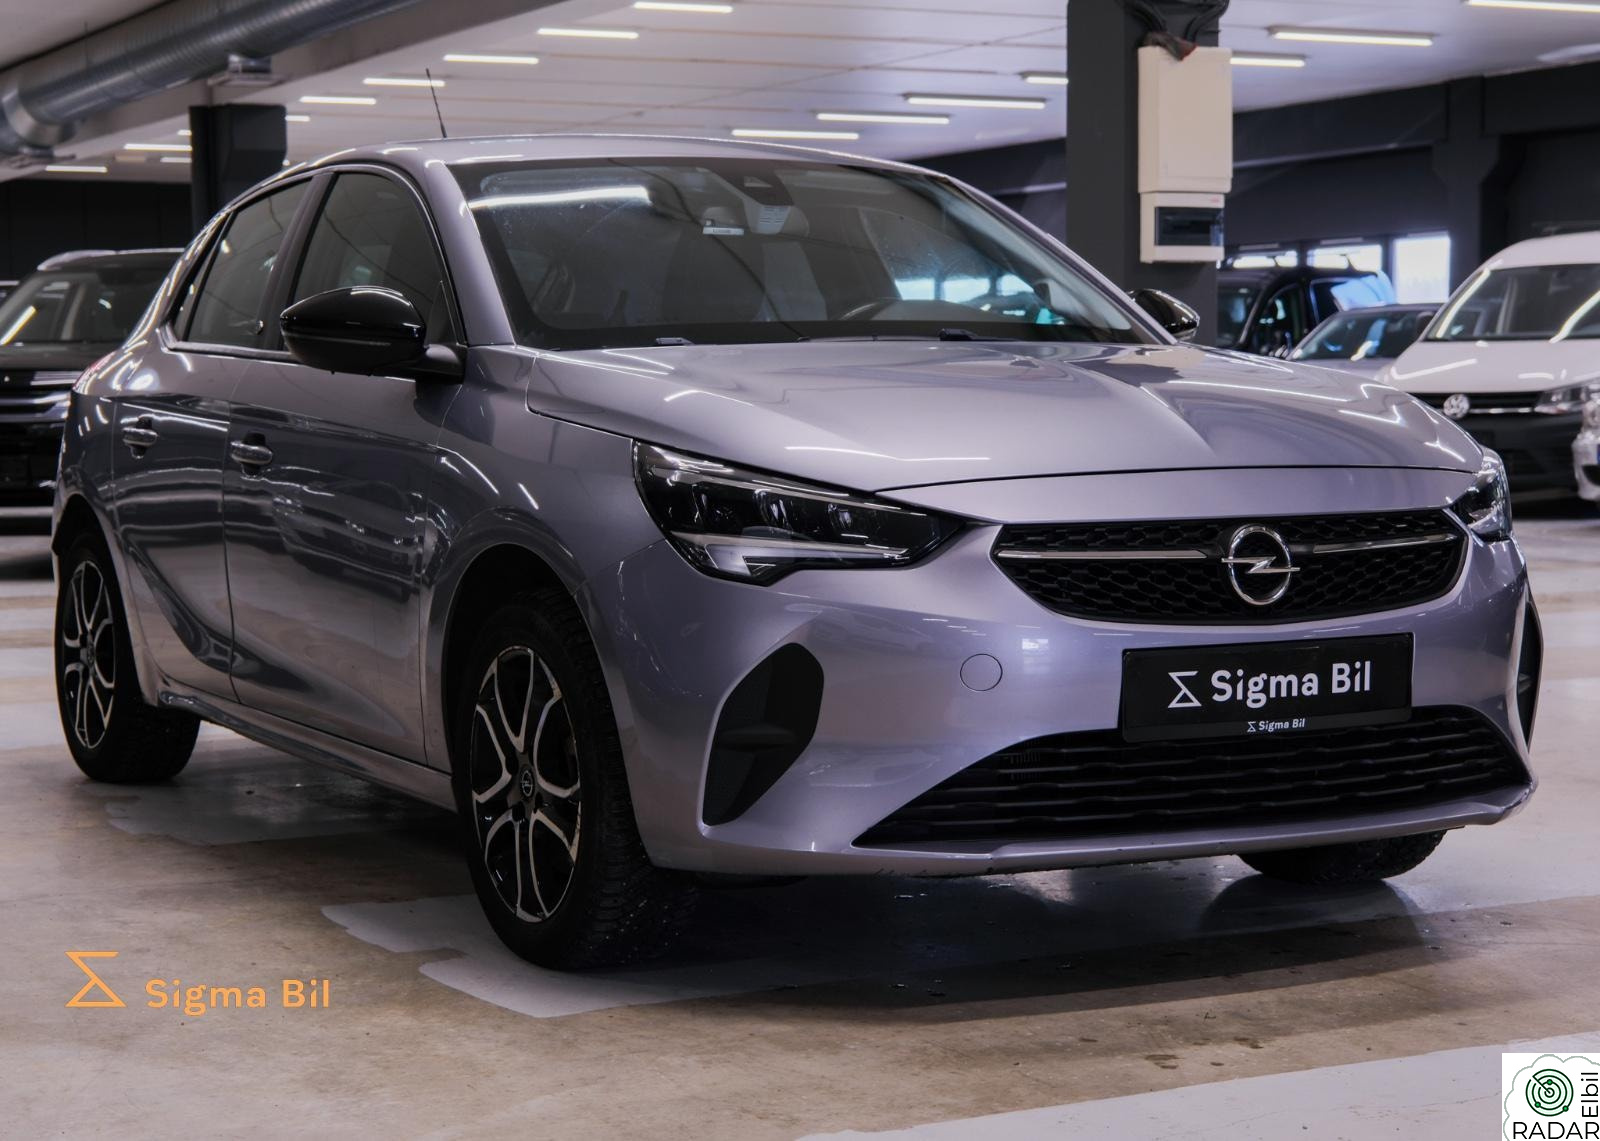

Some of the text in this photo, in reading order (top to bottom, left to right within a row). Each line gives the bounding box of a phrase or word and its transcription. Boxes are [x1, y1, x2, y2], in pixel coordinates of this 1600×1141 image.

[1211, 660, 1371, 709] Sigma Bil
[1258, 718, 1306, 732] Sigma Bil
